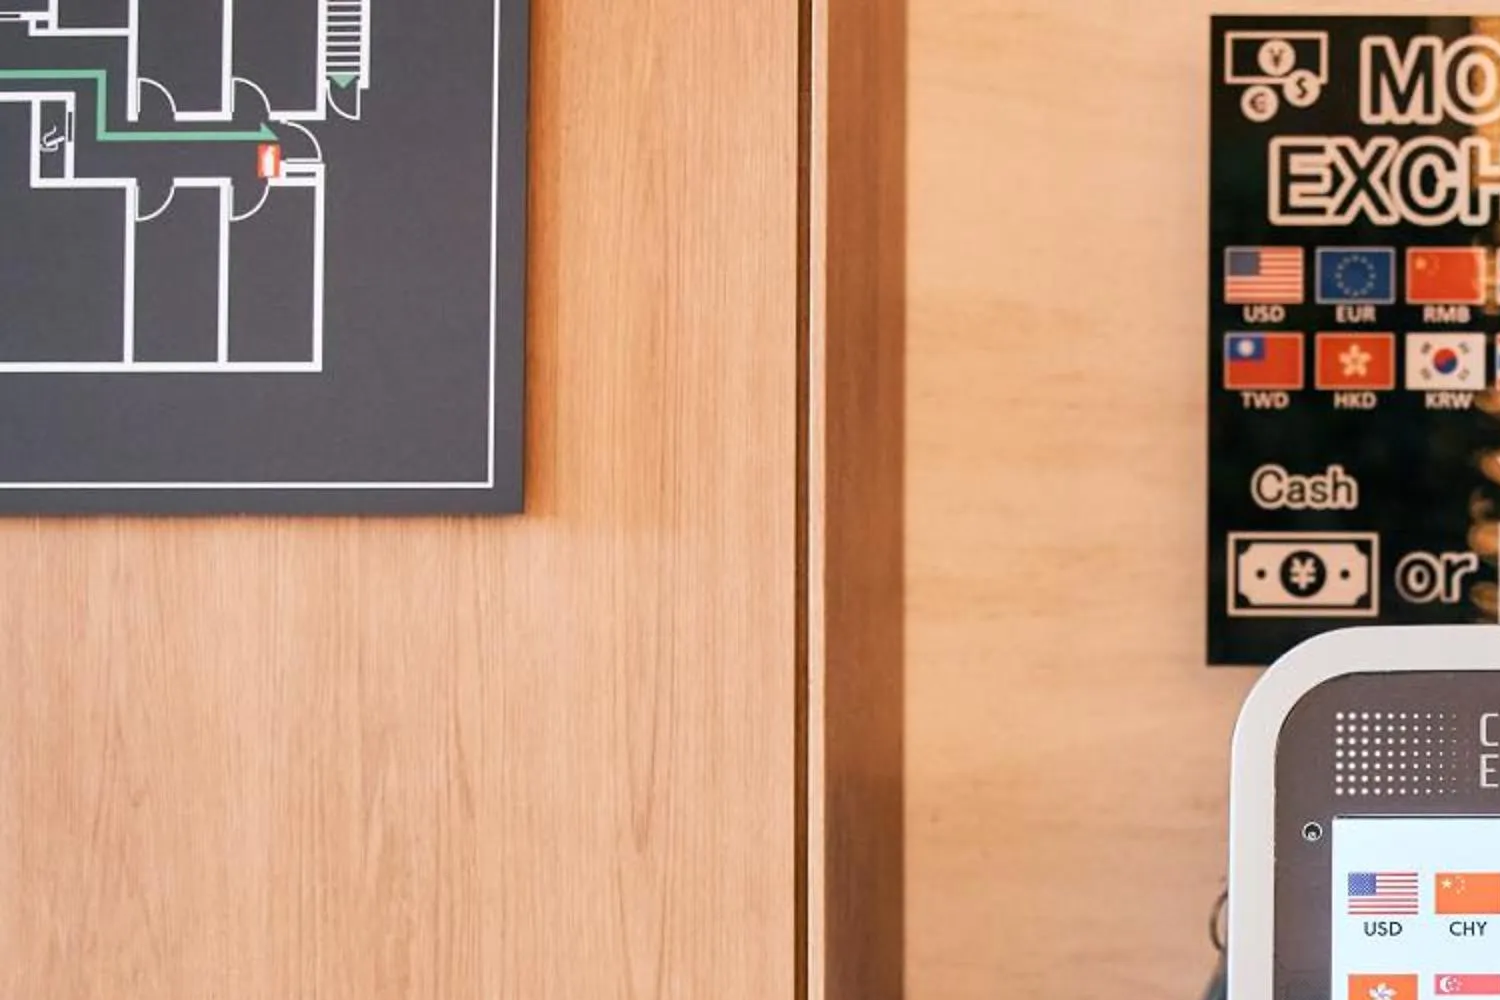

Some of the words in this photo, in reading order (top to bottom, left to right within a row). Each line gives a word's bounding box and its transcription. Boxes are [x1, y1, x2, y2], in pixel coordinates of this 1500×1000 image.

[1243, 306, 1285, 323] USD
[1336, 306, 1376, 323] EUR
[1423, 306, 1471, 324] RMB
[1241, 392, 1289, 409] TWD
[1334, 392, 1377, 409] HKD
[1425, 392, 1473, 409] KRW
[1251, 464, 1359, 510] Cash
[1396, 552, 1479, 603] or
[1364, 921, 1403, 937] USD
[1449, 921, 1487, 937] CHY
